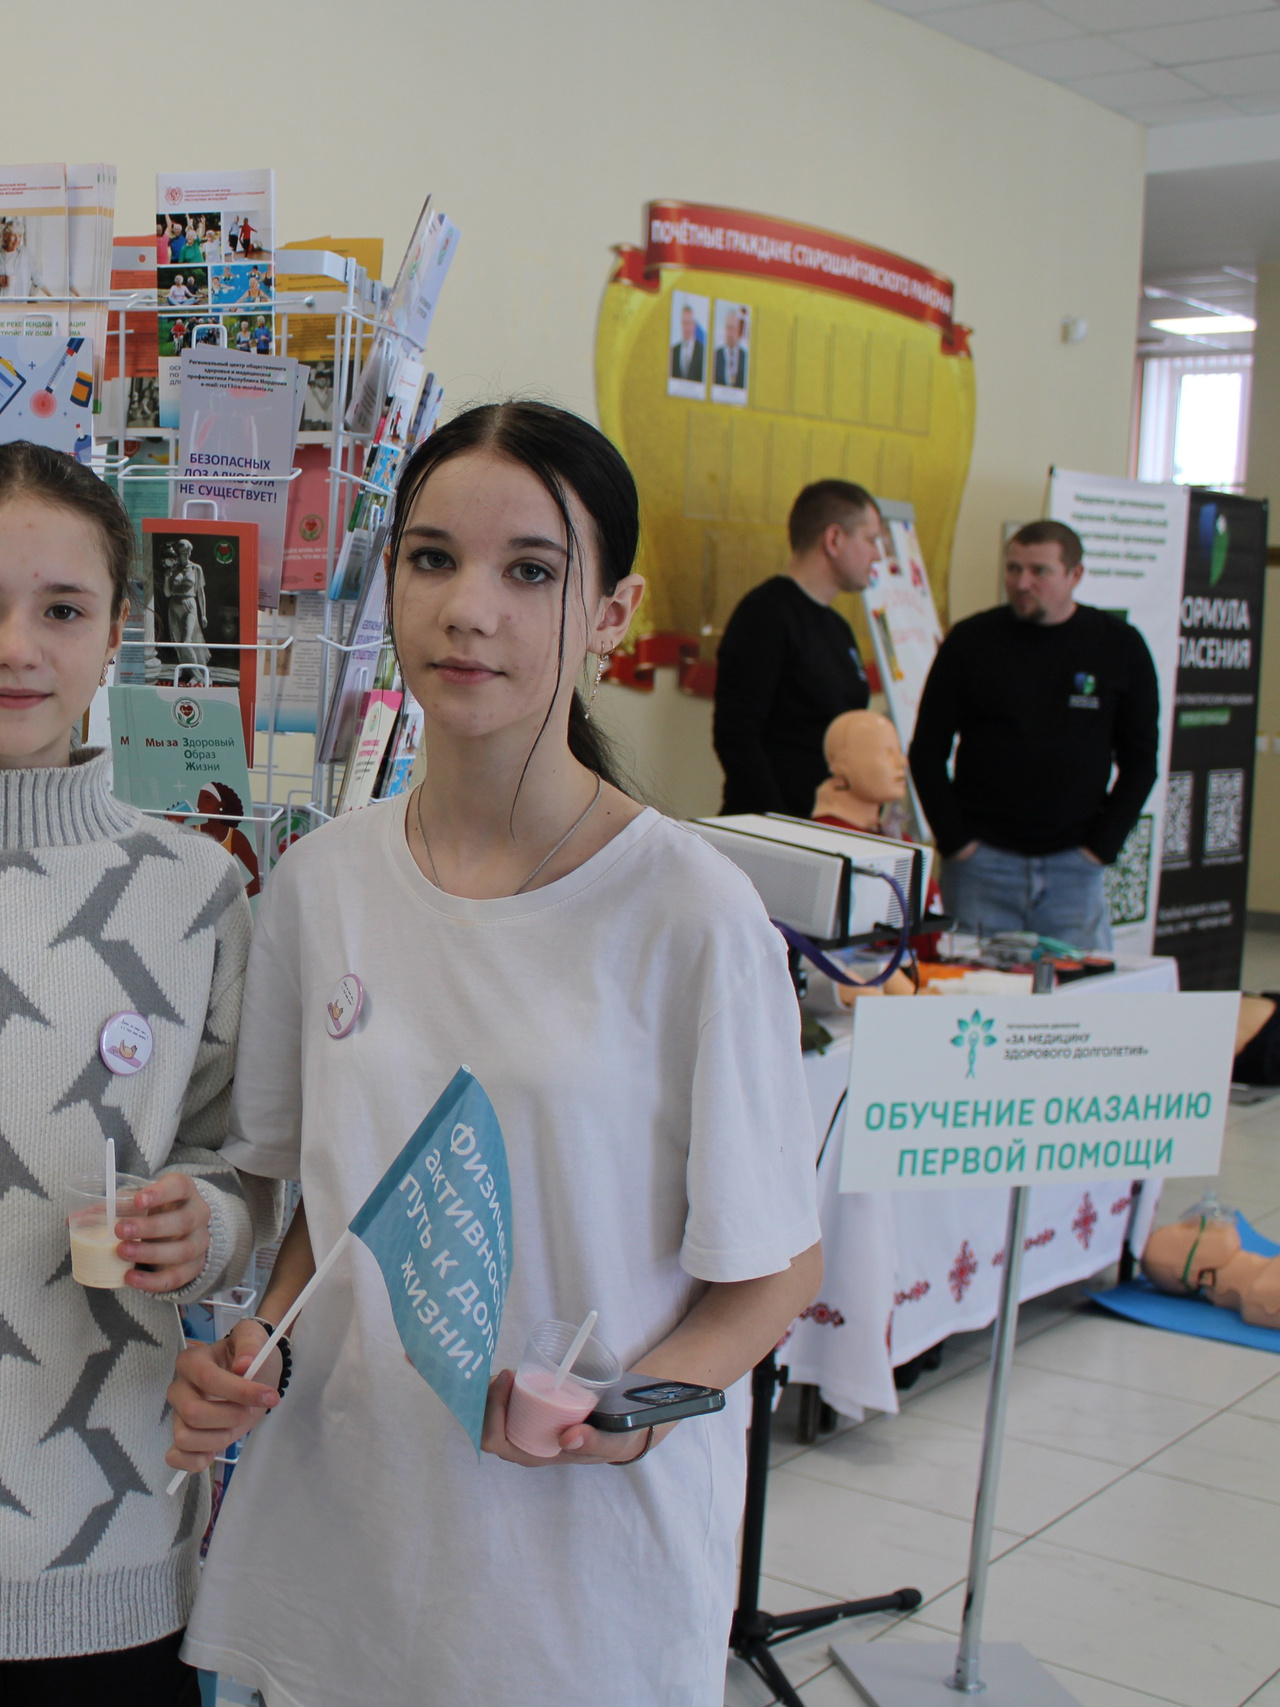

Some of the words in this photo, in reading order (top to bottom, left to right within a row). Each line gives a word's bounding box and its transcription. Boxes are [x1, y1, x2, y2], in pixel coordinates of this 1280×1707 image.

[651, 218, 723, 250] ПОЧЁТНЫЕ
[725, 227, 792, 261] ГРАЖДАНЕ
[190, 453, 271, 470] БЕЗОПАСНЫХ
[180, 483, 194, 495] НЕ
[198, 485, 277, 503] СУЩЕСТВУЕТ!
[1180, 595, 1251, 630] ОРМУЛА
[1178, 635, 1252, 669] ПАСЕНИЯ
[145, 738, 164, 747] Мы
[166, 739, 178, 747] за
[182, 737, 235, 749] Здоровый
[184, 749, 216, 761] Образ
[185, 761, 220, 771] Жизни
[1027, 1033, 1090, 1045] МЕДИЦИНУ
[1004, 1049, 1071, 1061] ЗДОРОВОГО
[865, 1099, 1035, 1131] ОБУЧЕНИЕ
[1044, 1091, 1213, 1125] ОКАЗАНИЮ
[897, 1139, 1027, 1178] ПЕРВОЙ
[1036, 1137, 1174, 1171] ПОМОЩИ
[398, 1173, 433, 1249] путь
[431, 1249, 459, 1280] к
[400, 1252, 484, 1380] жизни!
